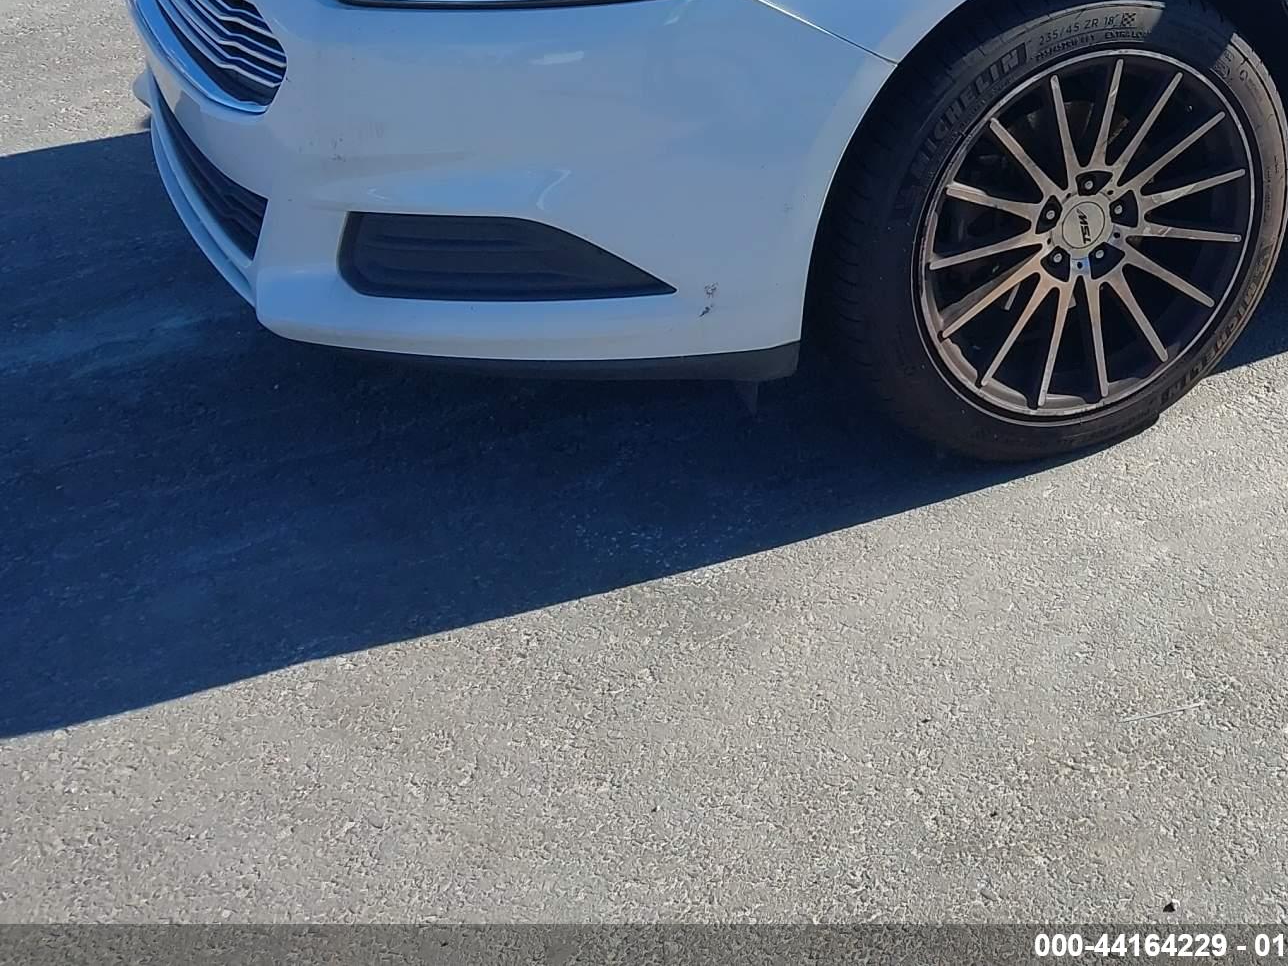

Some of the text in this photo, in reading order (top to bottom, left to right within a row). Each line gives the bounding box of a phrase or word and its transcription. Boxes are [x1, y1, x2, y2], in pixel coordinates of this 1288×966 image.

[1084, 19, 1099, 29] ZR
[909, 46, 1020, 181] MICHELIN
[1076, 208, 1091, 244] TSW
